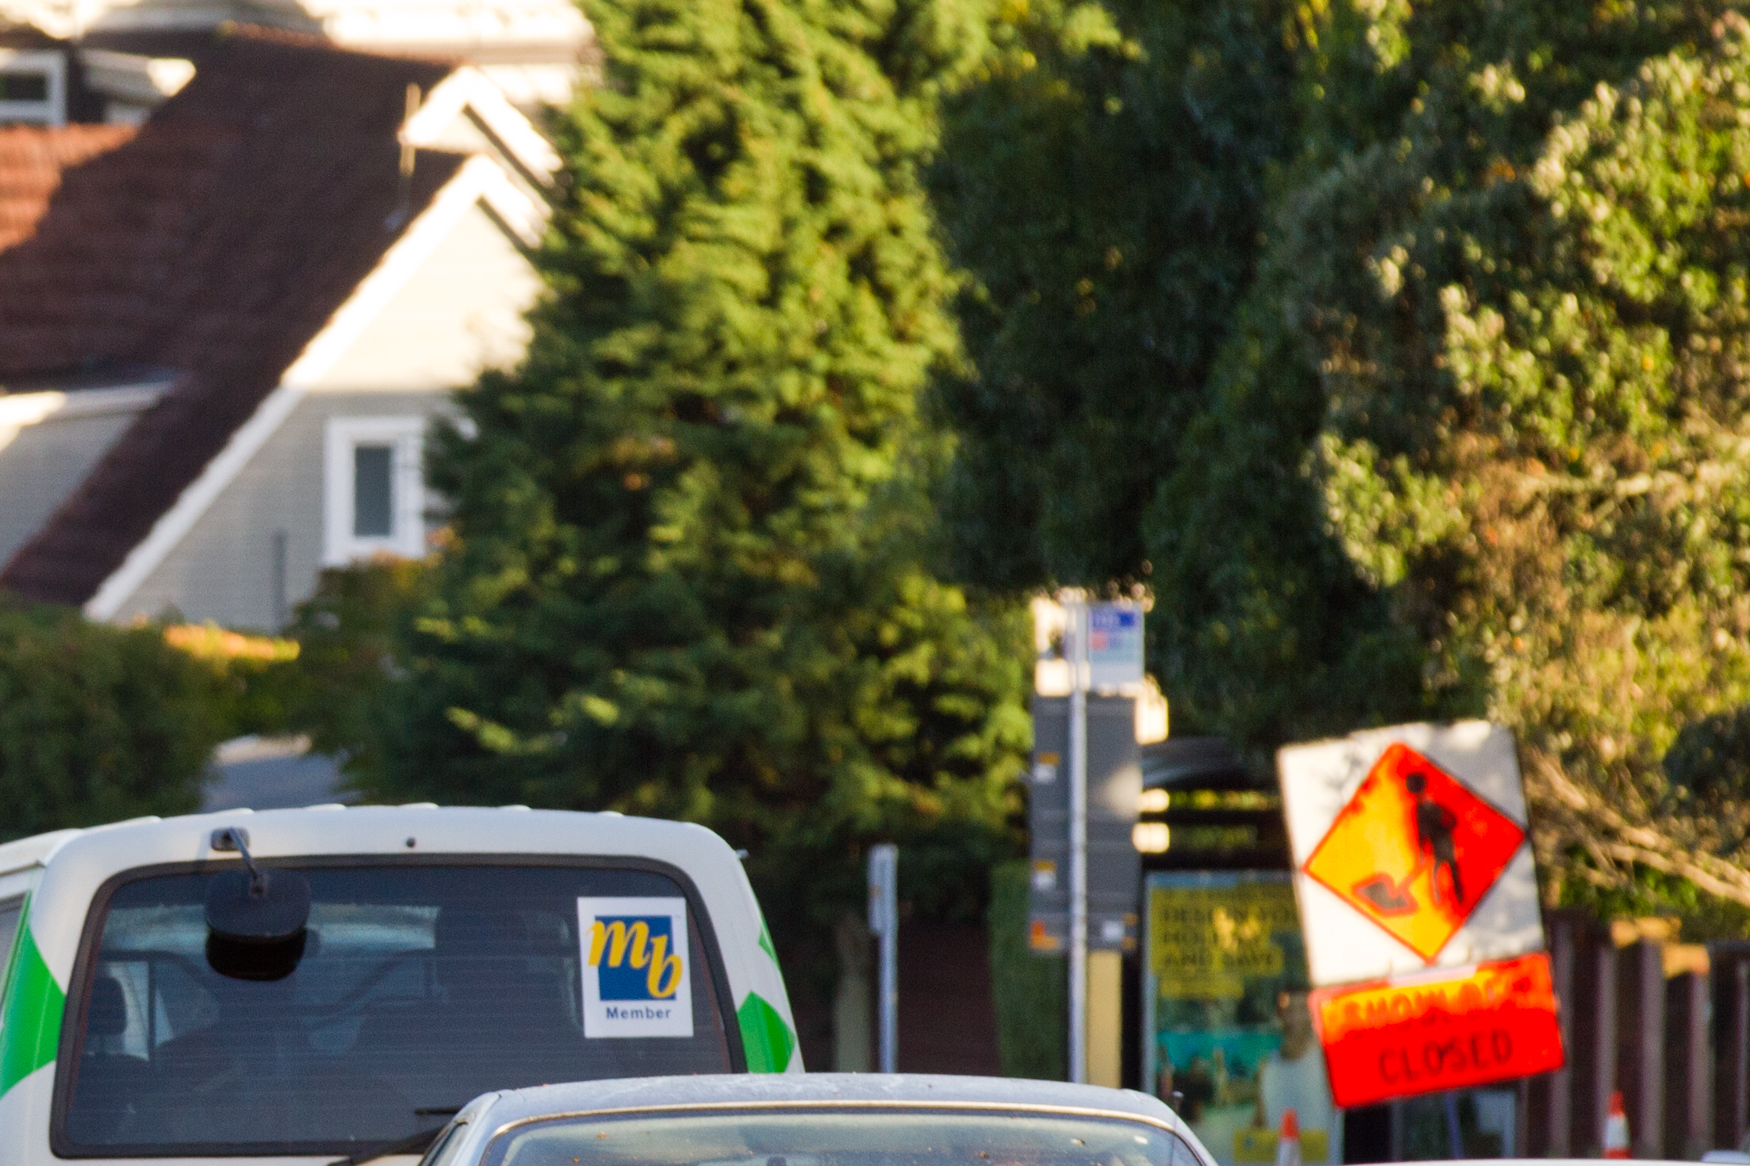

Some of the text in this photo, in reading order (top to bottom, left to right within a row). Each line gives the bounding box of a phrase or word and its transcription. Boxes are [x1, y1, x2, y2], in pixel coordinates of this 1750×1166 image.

[585, 920, 683, 999] mb
[606, 1006, 671, 1020] Member
[1378, 1028, 1513, 1085] CLOSED
